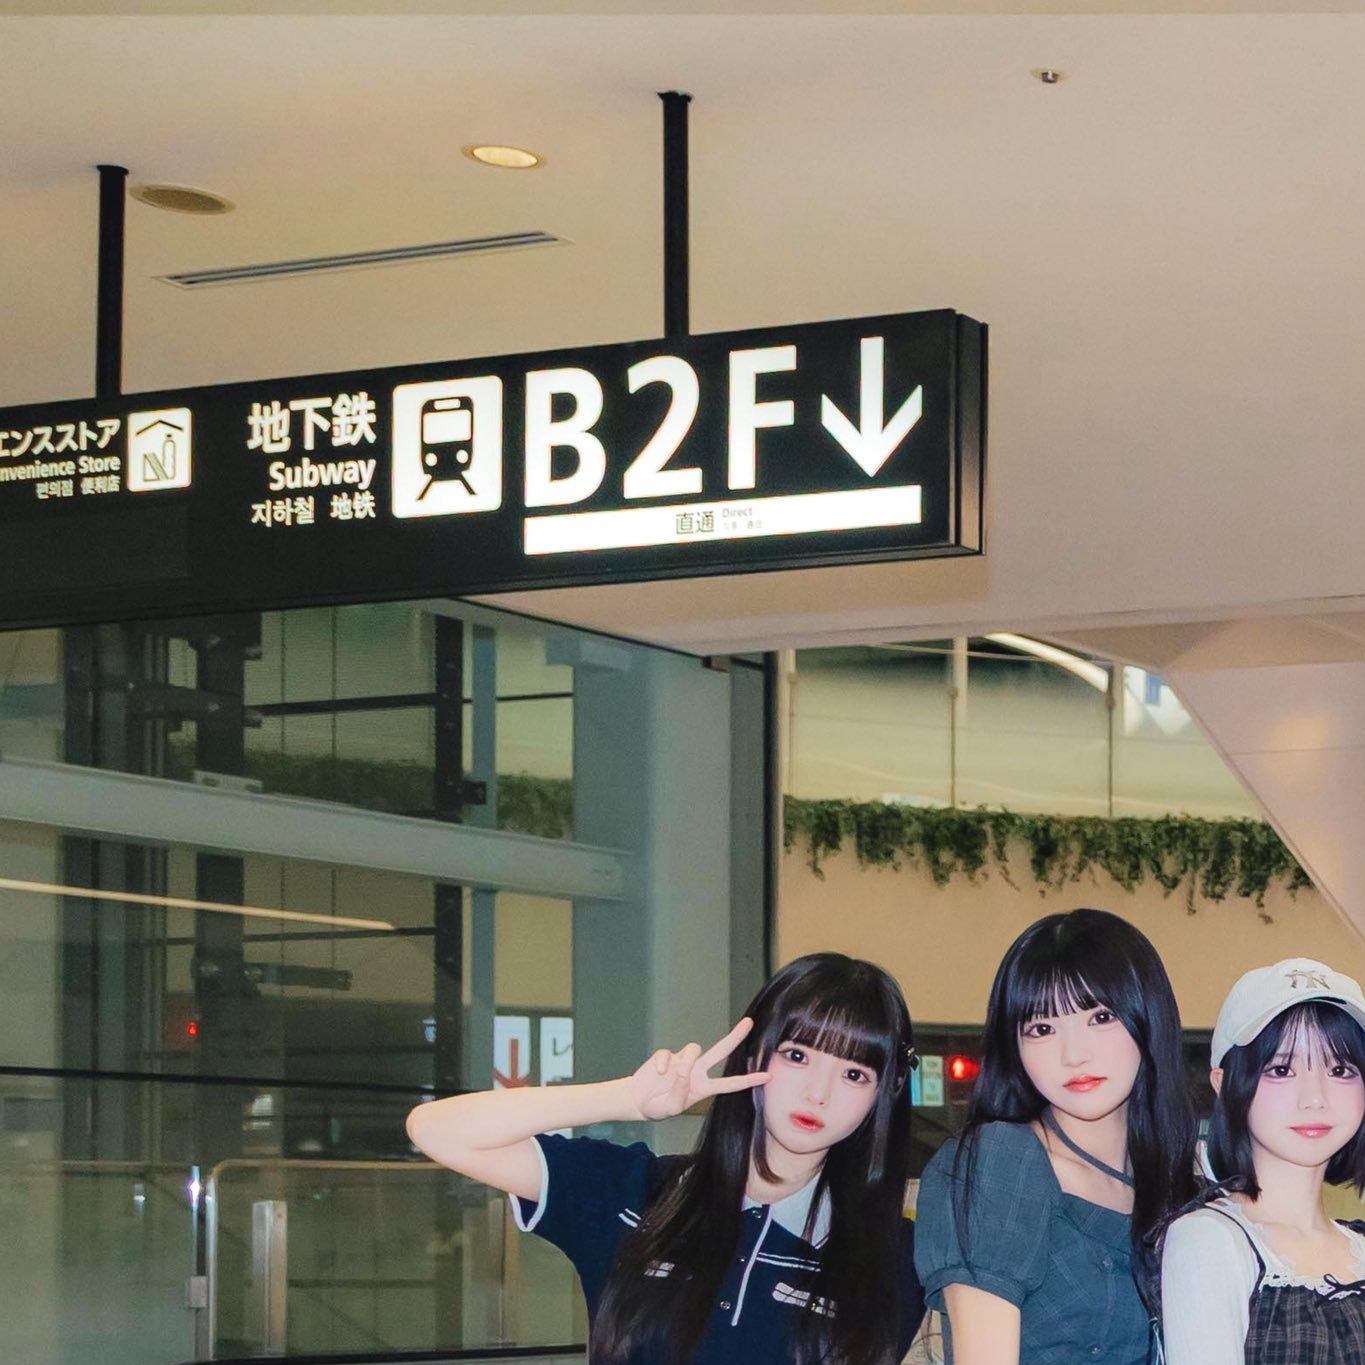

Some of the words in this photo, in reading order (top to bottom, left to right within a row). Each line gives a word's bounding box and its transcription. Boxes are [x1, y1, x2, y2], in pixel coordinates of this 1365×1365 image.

[247, 391, 378, 454] 地下鉄
[523, 344, 798, 508] B2F
[78, 455, 121, 474] Store
[268, 457, 376, 492] Subway
[250, 496, 316, 528] 지하철
[329, 491, 377, 520] 地铁
[721, 507, 753, 519] Direct
[675, 510, 715, 535] 直通
